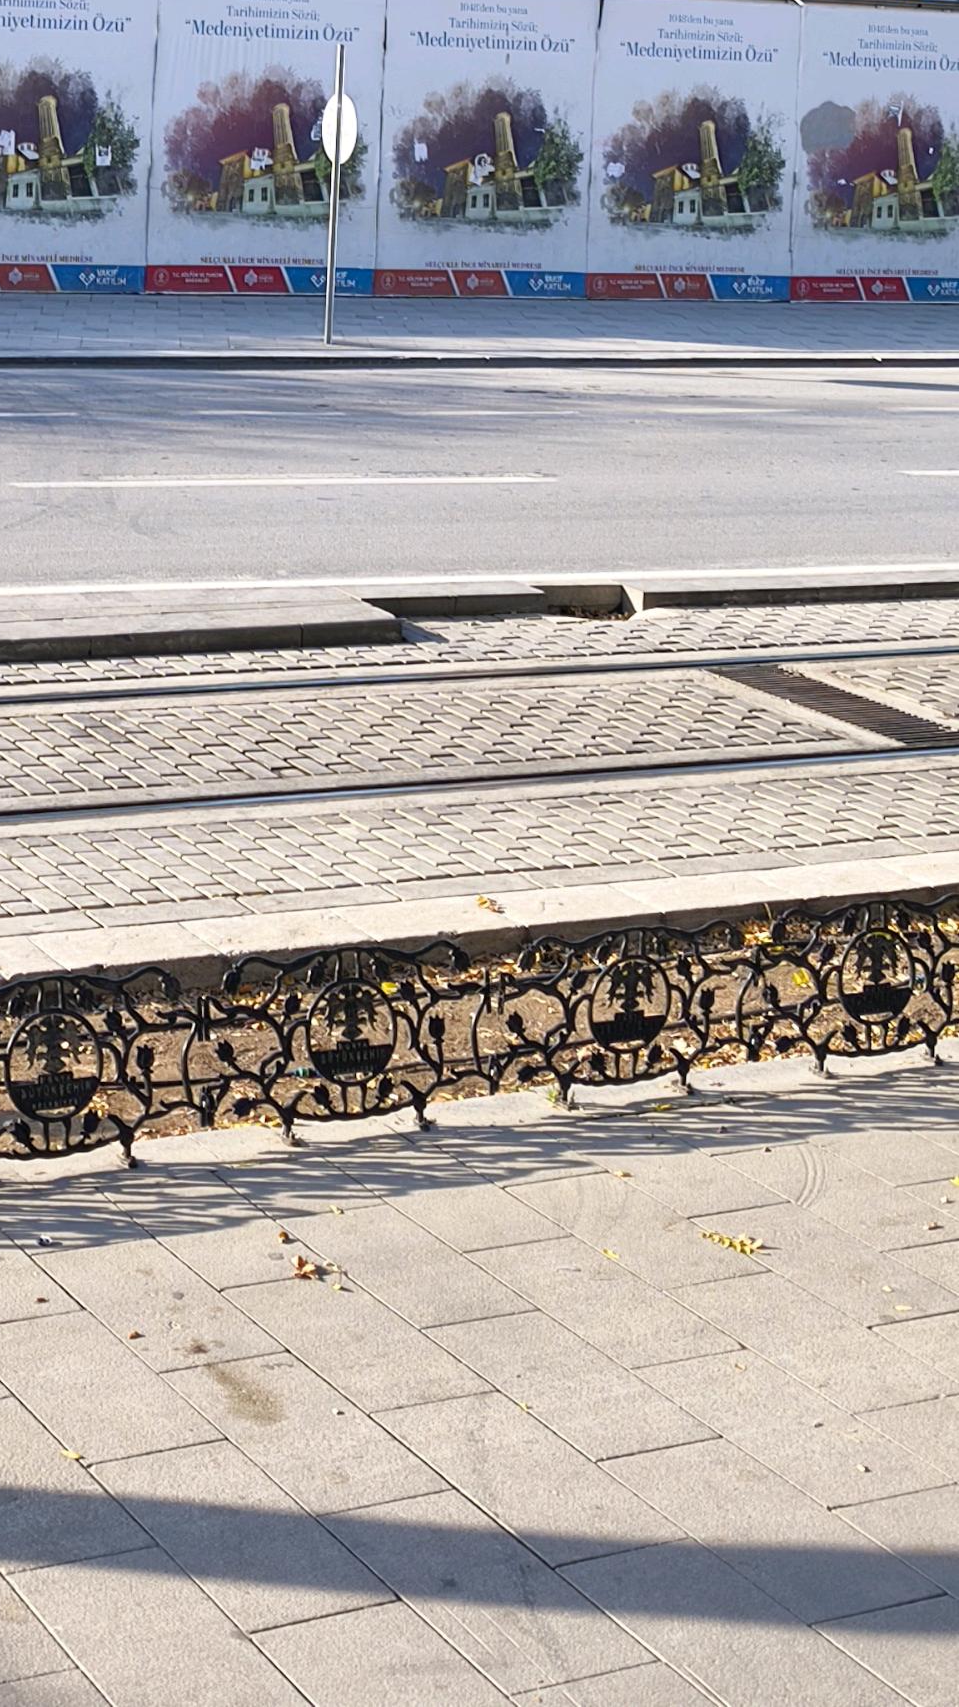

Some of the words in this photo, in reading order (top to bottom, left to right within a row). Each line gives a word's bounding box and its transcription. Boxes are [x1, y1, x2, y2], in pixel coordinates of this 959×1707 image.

[226, 6, 290, 20] Tarihimizin
[292, 8, 320, 22] Sözü;
[496, 4, 508, 14] bu
[508, 6, 528, 16] yana
[92, 13, 132, 32] Özü”
[448, 16, 508, 30] Tarihimizin
[704, 15, 714, 24] bu
[714, 18, 734, 27] yana
[186, 19, 319, 42] “Medeniyetimizin
[323, 23, 360, 42] Özü”
[658, 28, 716, 42] Tarihimizin
[410, 31, 538, 52] “Medeniyetimizin
[858, 38, 912, 51] Tarihimizin
[620, 42, 742, 62] “Medeniyetimizin
[822, 52, 936, 72] “Medeniyetimizin
